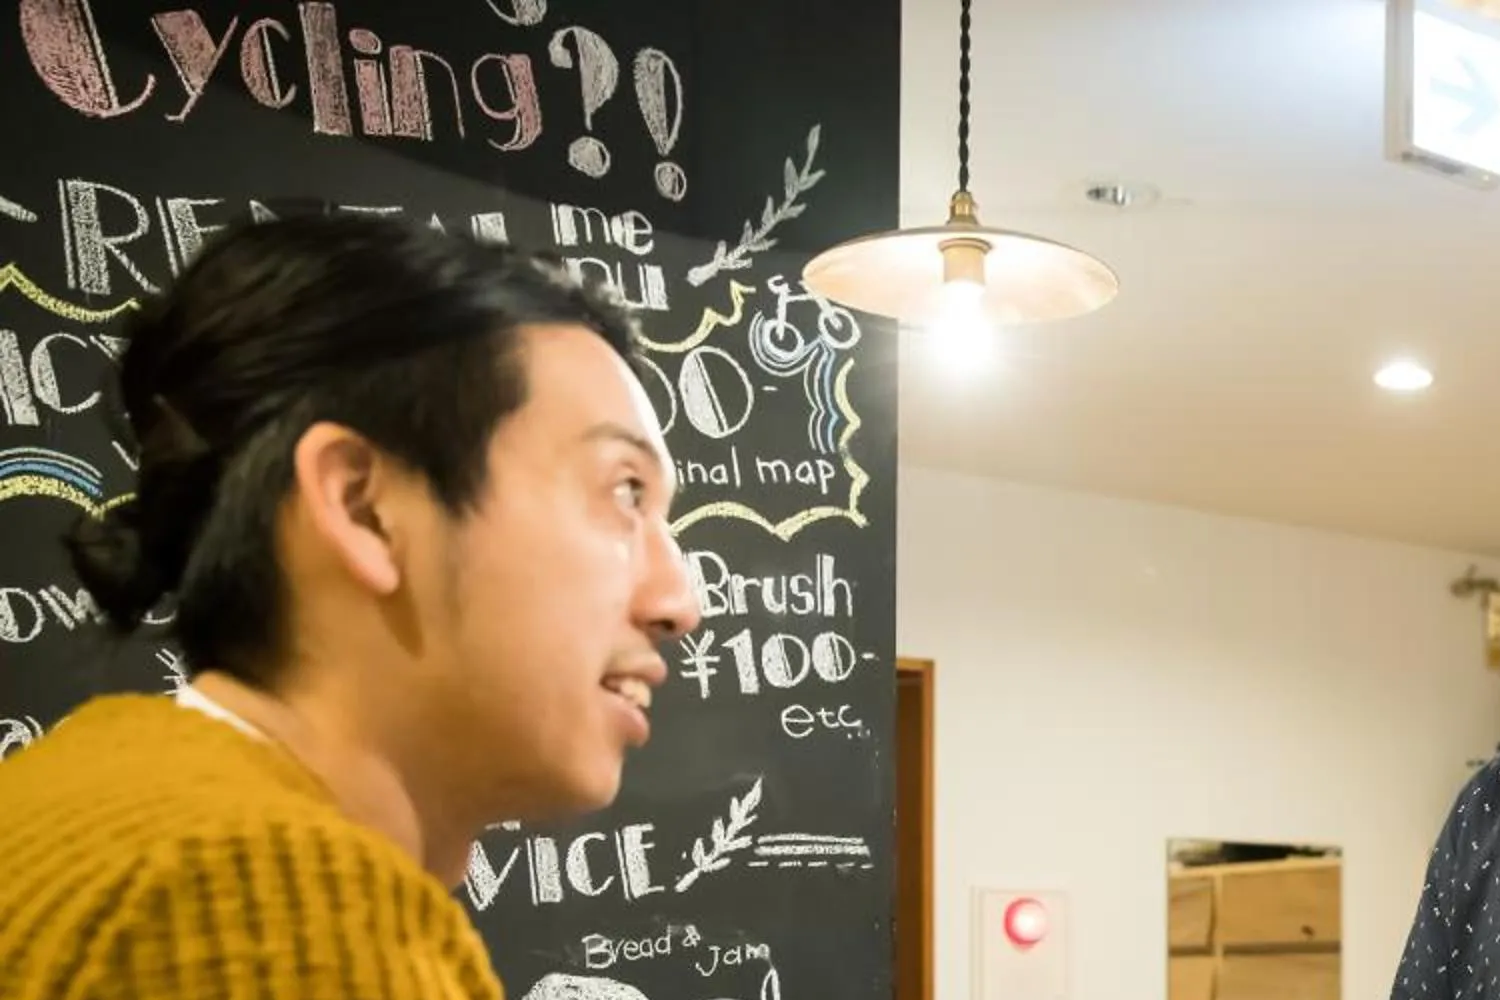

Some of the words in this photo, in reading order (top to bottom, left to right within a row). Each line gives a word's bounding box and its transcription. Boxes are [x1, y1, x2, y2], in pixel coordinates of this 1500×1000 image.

[551, 203, 654, 256] me
[755, 457, 835, 494] map
[684, 551, 853, 618] Brush
[581, 923, 672, 969] Bread
